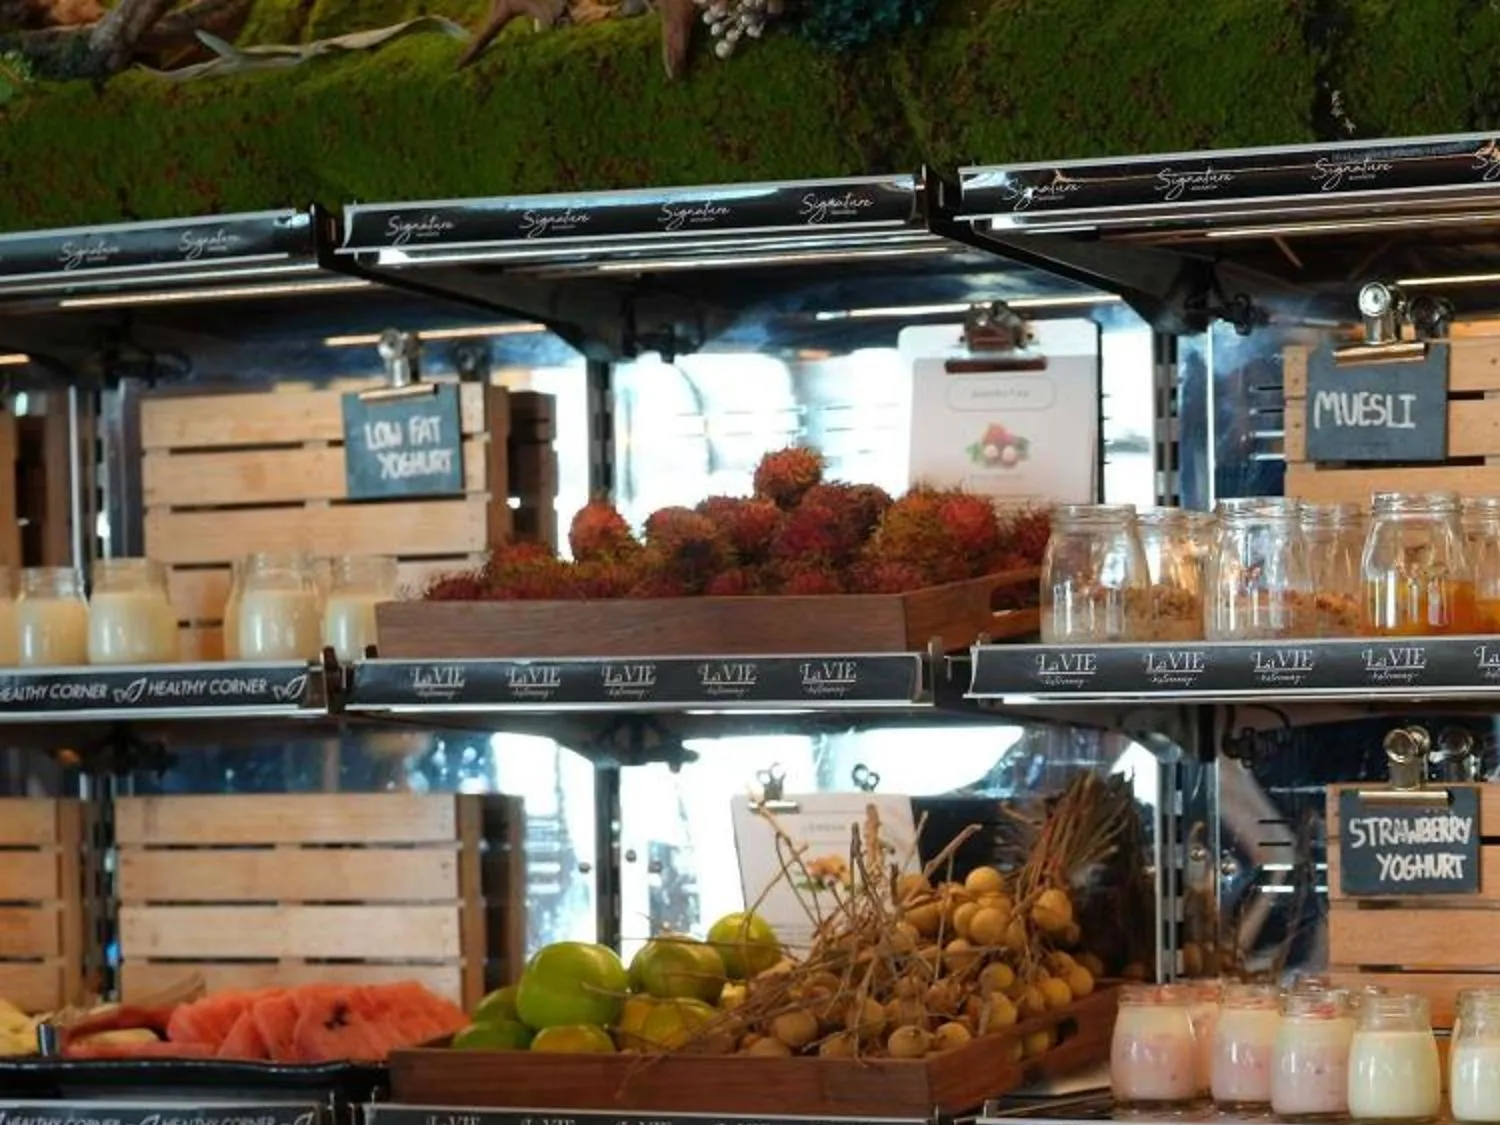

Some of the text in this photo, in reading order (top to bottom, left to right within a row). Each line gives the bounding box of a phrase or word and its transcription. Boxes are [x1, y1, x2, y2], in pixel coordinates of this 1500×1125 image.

[1314, 391, 1416, 429] MUESLI
[364, 416, 441, 451] LOW FAT
[50, 684, 107, 699] CORNER
[149, 680, 207, 696] HEALTHY
[209, 678, 267, 694] CORNER
[1376, 853, 1466, 881] YOGHURT
